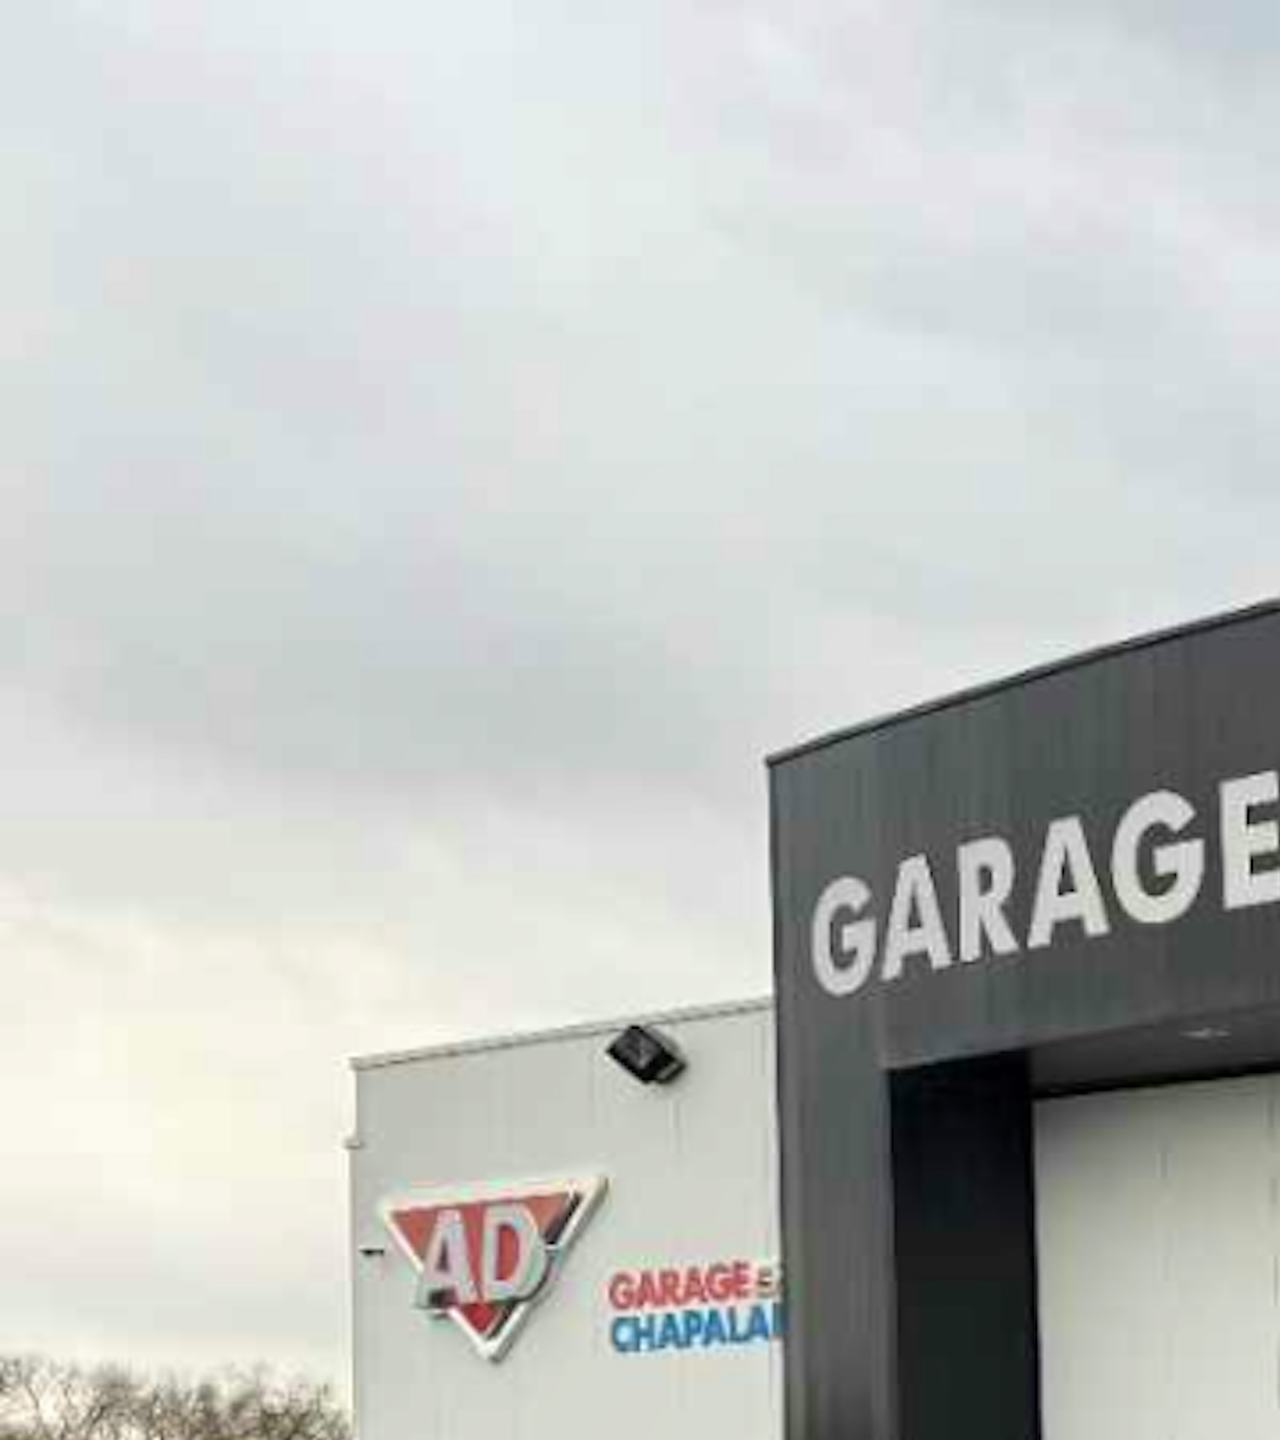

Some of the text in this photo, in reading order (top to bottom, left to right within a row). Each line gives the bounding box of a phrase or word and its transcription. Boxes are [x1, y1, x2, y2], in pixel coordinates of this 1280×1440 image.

[417, 1204, 547, 1308] AD
[609, 1261, 750, 1310] GARAGE
[611, 1301, 784, 1353] CHAPALAI
